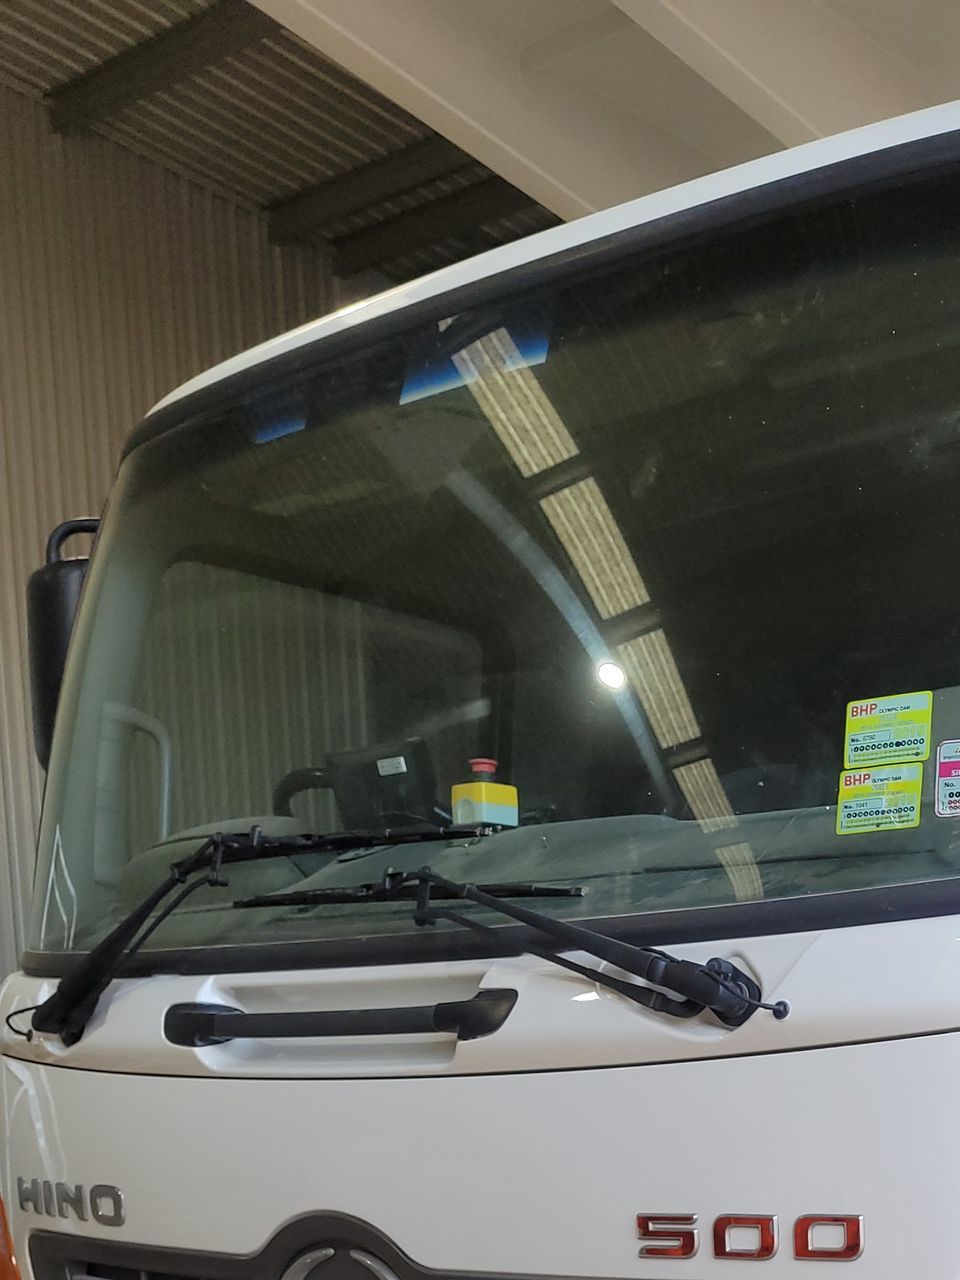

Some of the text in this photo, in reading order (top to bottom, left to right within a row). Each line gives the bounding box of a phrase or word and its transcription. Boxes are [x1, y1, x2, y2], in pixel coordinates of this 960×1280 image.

[851, 703, 877, 718] BHP
[844, 773, 871, 787] BHP
[17, 1176, 126, 1227] HINO
[636, 1213, 865, 1262] 500
